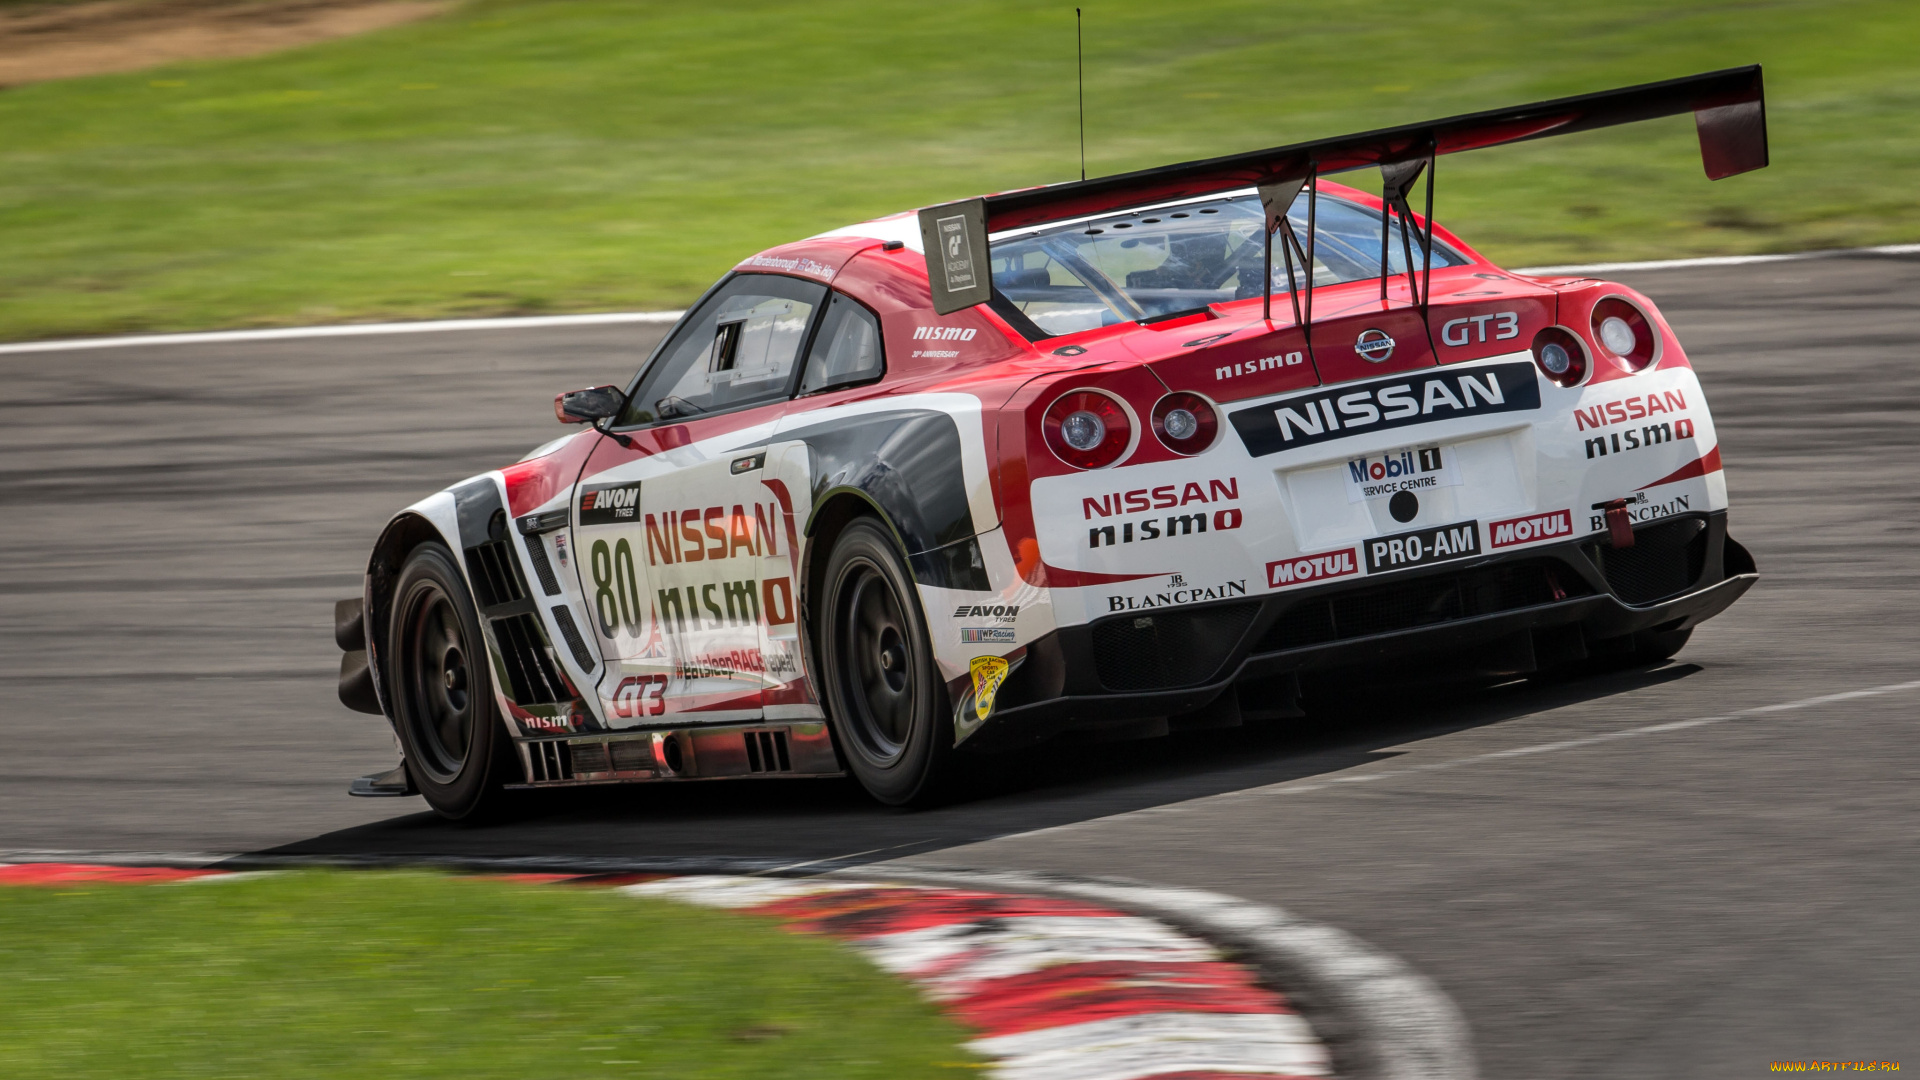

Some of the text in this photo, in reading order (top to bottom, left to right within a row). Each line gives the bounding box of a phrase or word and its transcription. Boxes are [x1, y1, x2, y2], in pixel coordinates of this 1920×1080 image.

[943, 223, 962, 232] NISSAN
[804, 260, 822, 275] Chris
[820, 264, 837, 281] Hoy
[912, 326, 978, 341] nismo
[1360, 339, 1392, 350] NISSAN
[1441, 311, 1520, 347] GT3
[921, 350, 960, 358] ANNIVERSARY
[1215, 351, 1303, 381] nismo
[1274, 372, 1506, 442] NISSAN
[1573, 388, 1687, 432] NISSAN
[1584, 418, 1694, 460] nismo
[1348, 451, 1415, 484] Mobil
[593, 488, 639, 509] AVON
[1082, 476, 1239, 520] NISSAN
[1363, 476, 1437, 497] SERVICE CENTRE
[615, 508, 634, 518] TYRES
[1089, 508, 1243, 549] nismo
[1494, 513, 1569, 545] MOTUL
[1589, 494, 1690, 532] BNCPAIN
[644, 502, 777, 567] NISSAN
[1371, 525, 1475, 568] PRO-AM
[1272, 552, 1354, 585] MOTUL
[591, 537, 642, 640] 80
[658, 576, 795, 634] nismo
[1107, 579, 1247, 612] BLANCPAIN
[967, 605, 1020, 617] AVON
[611, 673, 669, 719] GT3
[525, 714, 584, 729] nismo
